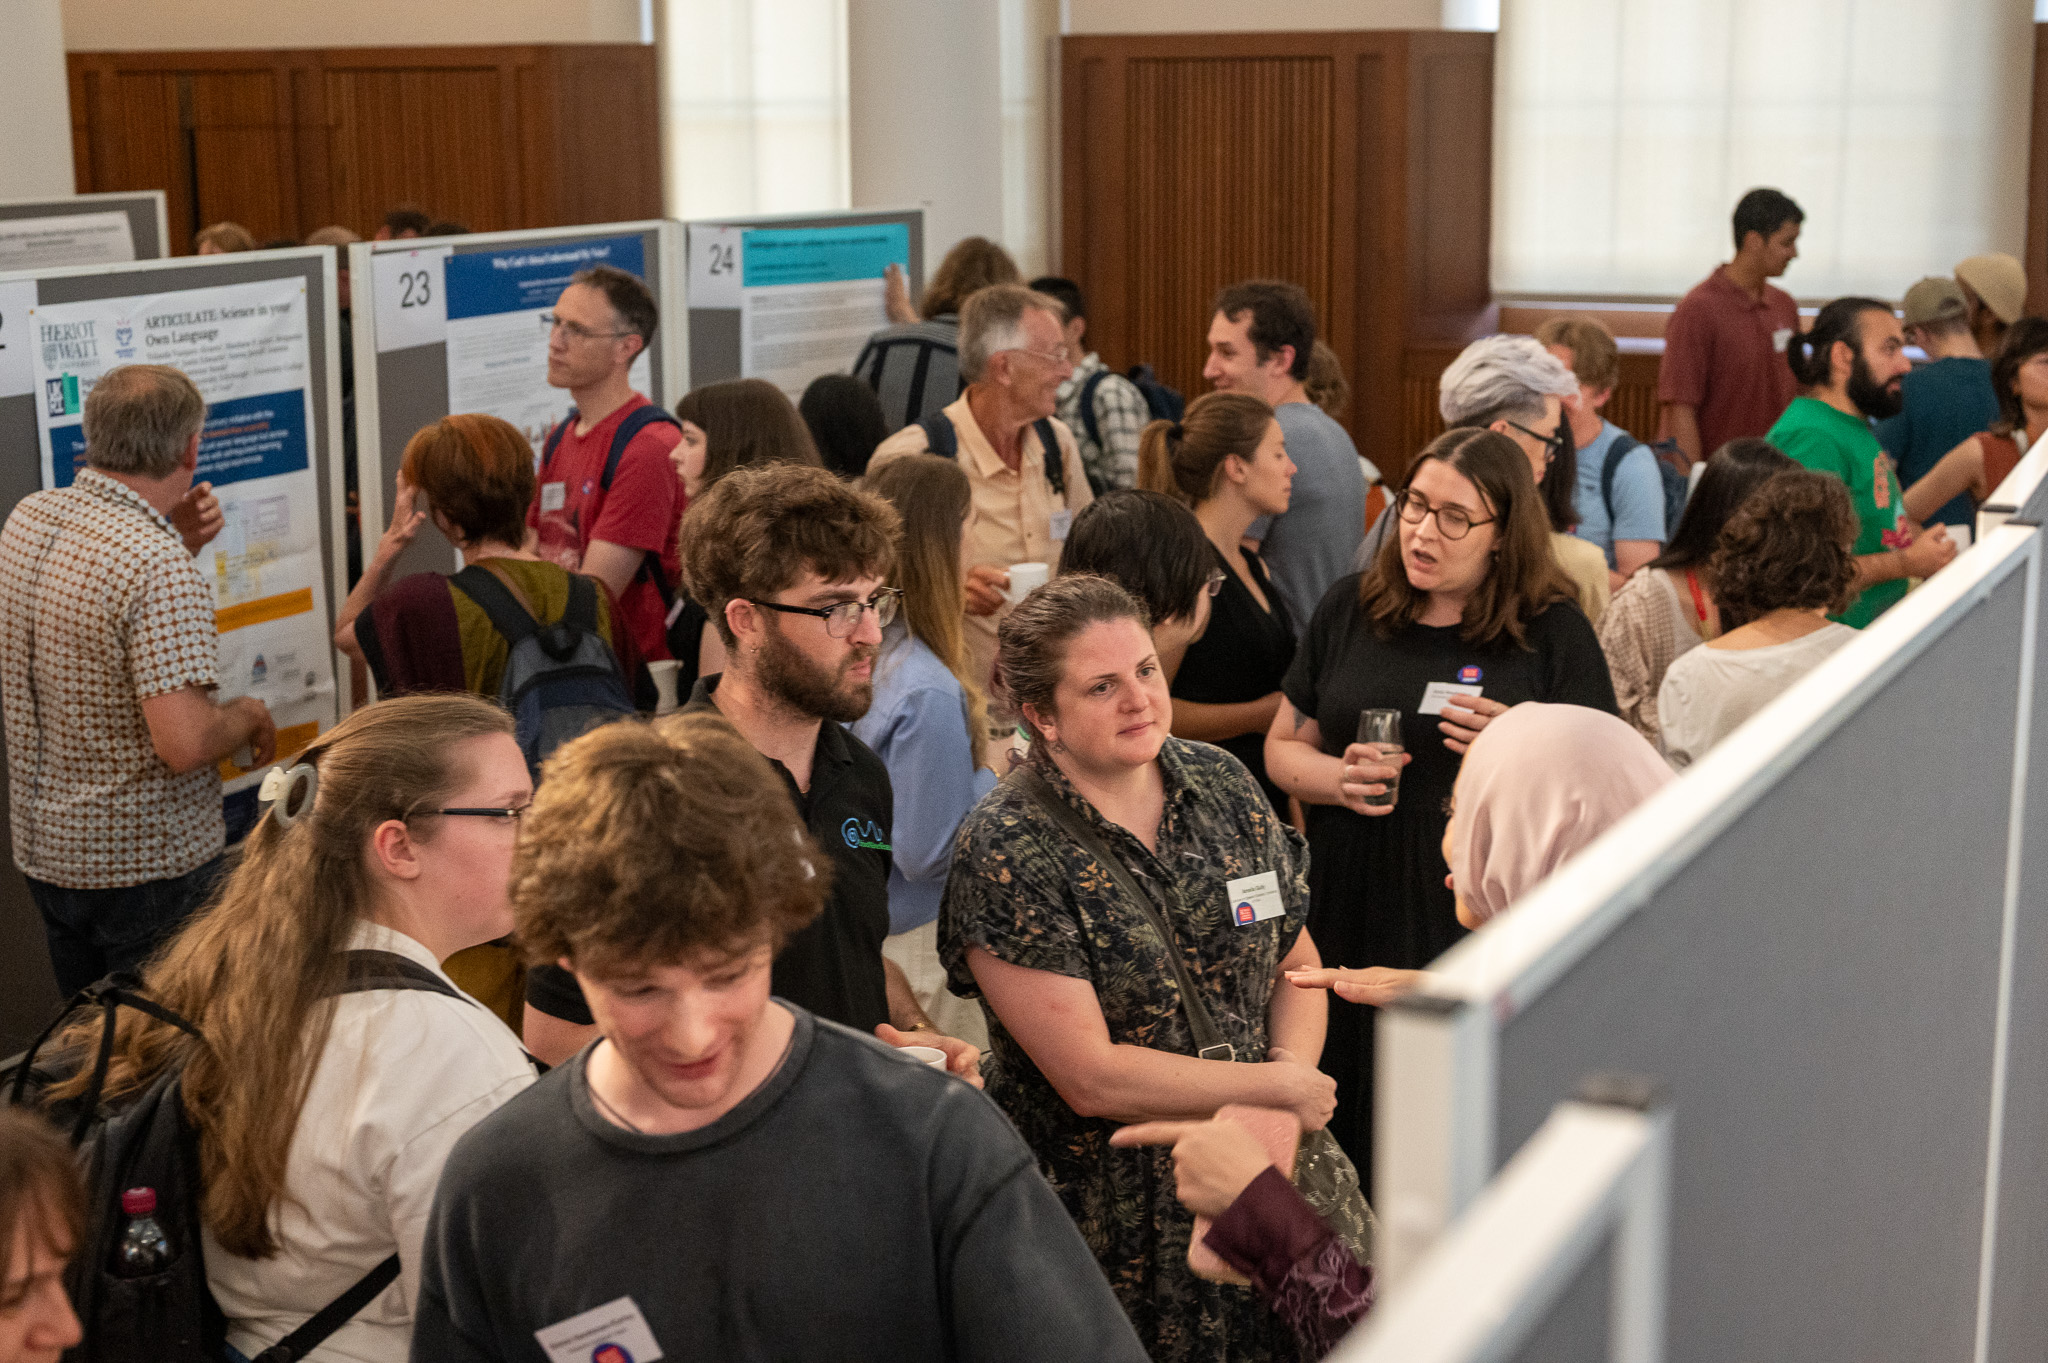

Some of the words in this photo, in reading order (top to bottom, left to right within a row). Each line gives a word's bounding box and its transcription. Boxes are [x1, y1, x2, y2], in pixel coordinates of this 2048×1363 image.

[709, 243, 734, 275] 24
[399, 270, 430, 307] 23
[145, 309, 217, 330] ARTICULATE
[220, 306, 255, 319] Science
[40, 320, 95, 342] HERIOT
[145, 333, 169, 347] Own
[172, 328, 218, 345] Language
[58, 339, 98, 359] WATT
